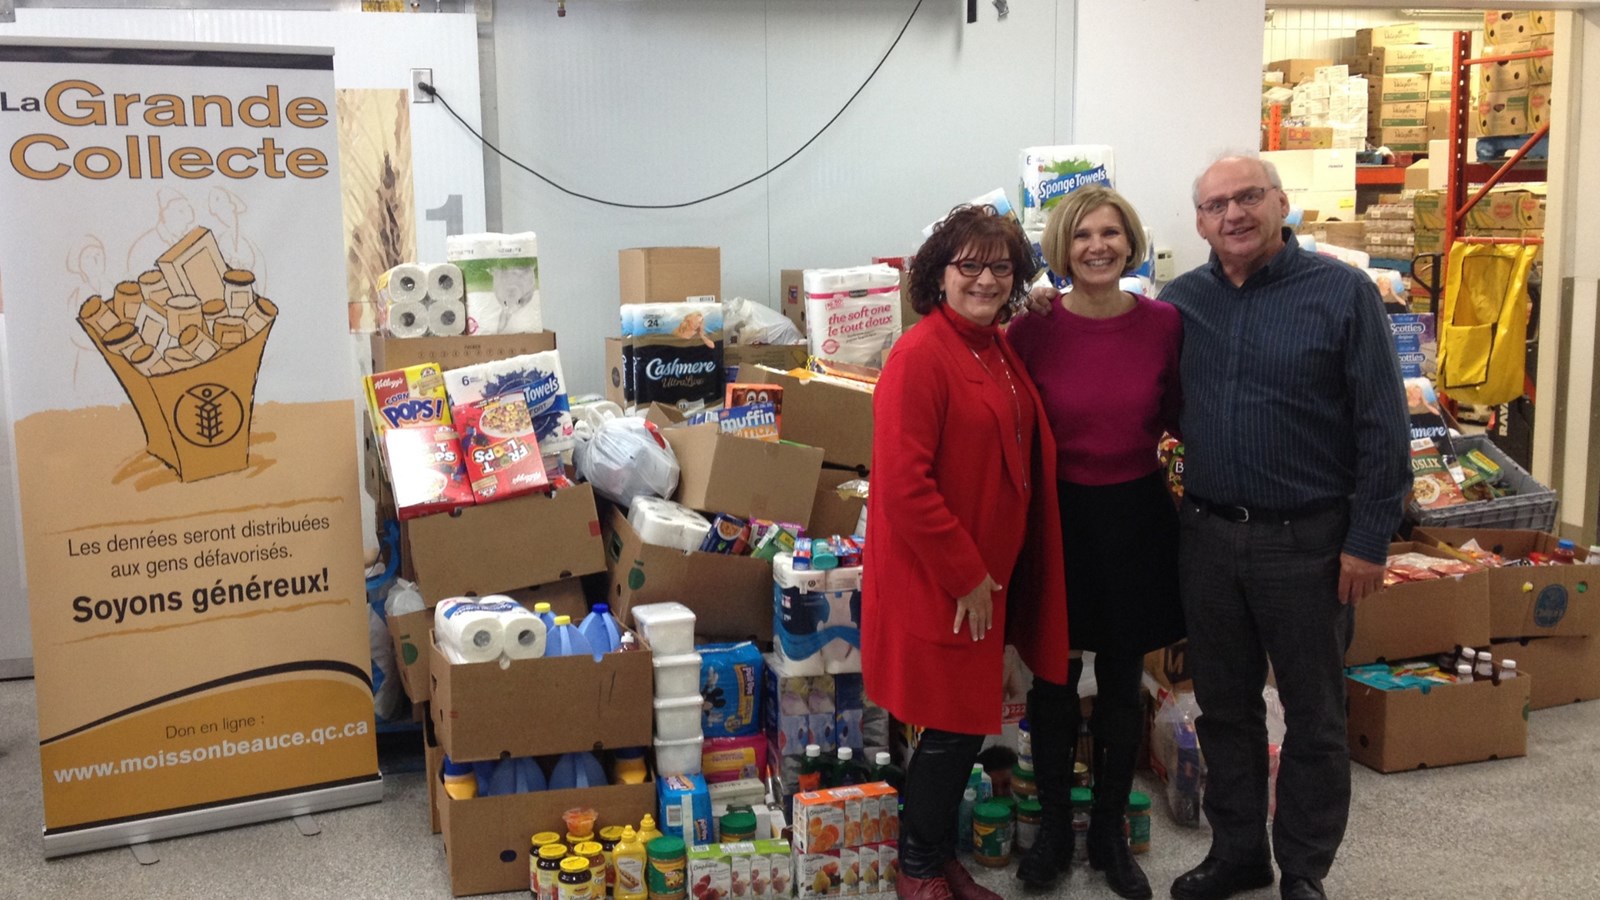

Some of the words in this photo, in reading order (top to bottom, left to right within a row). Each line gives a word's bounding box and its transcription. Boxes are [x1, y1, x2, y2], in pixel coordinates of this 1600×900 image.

[0, 92, 40, 112] La
[44, 79, 329, 129] Grande
[9, 133, 329, 180] Collecte
[647, 319, 659, 328] 24
[827, 325, 838, 337] le
[840, 321, 864, 334] tout
[865, 315, 893, 327] doux
[828, 313, 846, 325] the
[848, 306, 870, 320] soft
[871, 304, 892, 315] one
[1390, 323, 1422, 335] Scotties
[462, 375, 470, 386] 6
[645, 357, 717, 381] Cashmere
[374, 376, 404, 390] Kellogg's
[523, 377, 559, 403] Towels
[385, 392, 409, 405] CORN
[382, 399, 442, 428] POPS!
[720, 409, 775, 433] muffin
[1498, 402, 1508, 437] RAY
[68, 538, 101, 557] Les
[106, 530, 178, 553] denrées
[183, 524, 236, 545] seront
[241, 514, 330, 538] distribuées
[110, 562, 140, 578] aux
[146, 557, 188, 579] gens
[193, 541, 293, 569] défavorisés.
[72, 590, 183, 624] Soyons
[192, 567, 330, 613] généreux!
[165, 725, 196, 740] Don
[200, 722, 218, 734] en
[223, 715, 256, 733] ligne
[53, 720, 369, 784] www.moissonbeauce.qc.ca
